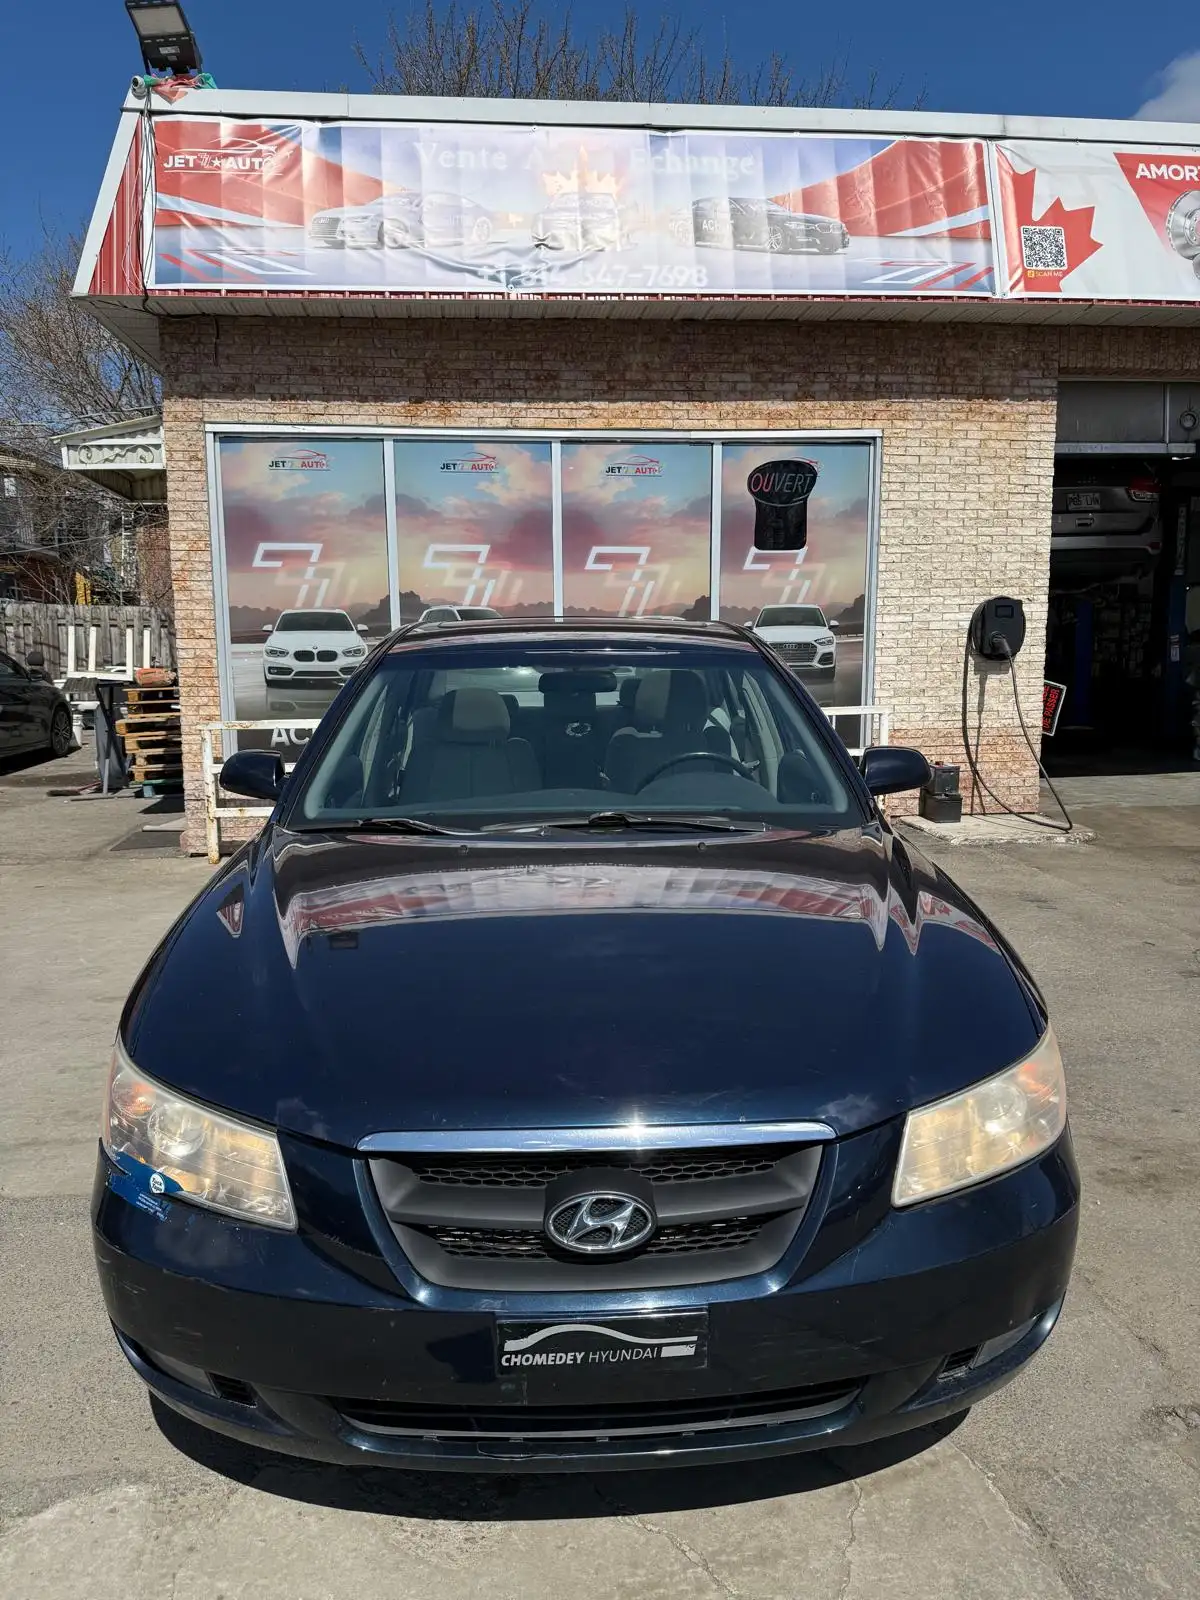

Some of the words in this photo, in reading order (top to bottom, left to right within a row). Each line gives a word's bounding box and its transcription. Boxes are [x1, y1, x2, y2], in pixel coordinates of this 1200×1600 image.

[163, 155, 198, 168] JET
[1136, 162, 1200, 182] AMOR
[269, 460, 287, 468] JET
[300, 460, 326, 469] AUTO
[440, 462, 458, 470] JET
[471, 463, 495, 471] AUTO
[605, 466, 622, 474] JET
[751, 472, 814, 493] OUVERT
[501, 1351, 585, 1367] CHOMEDEY
[588, 1346, 659, 1364] HYUNDAI
